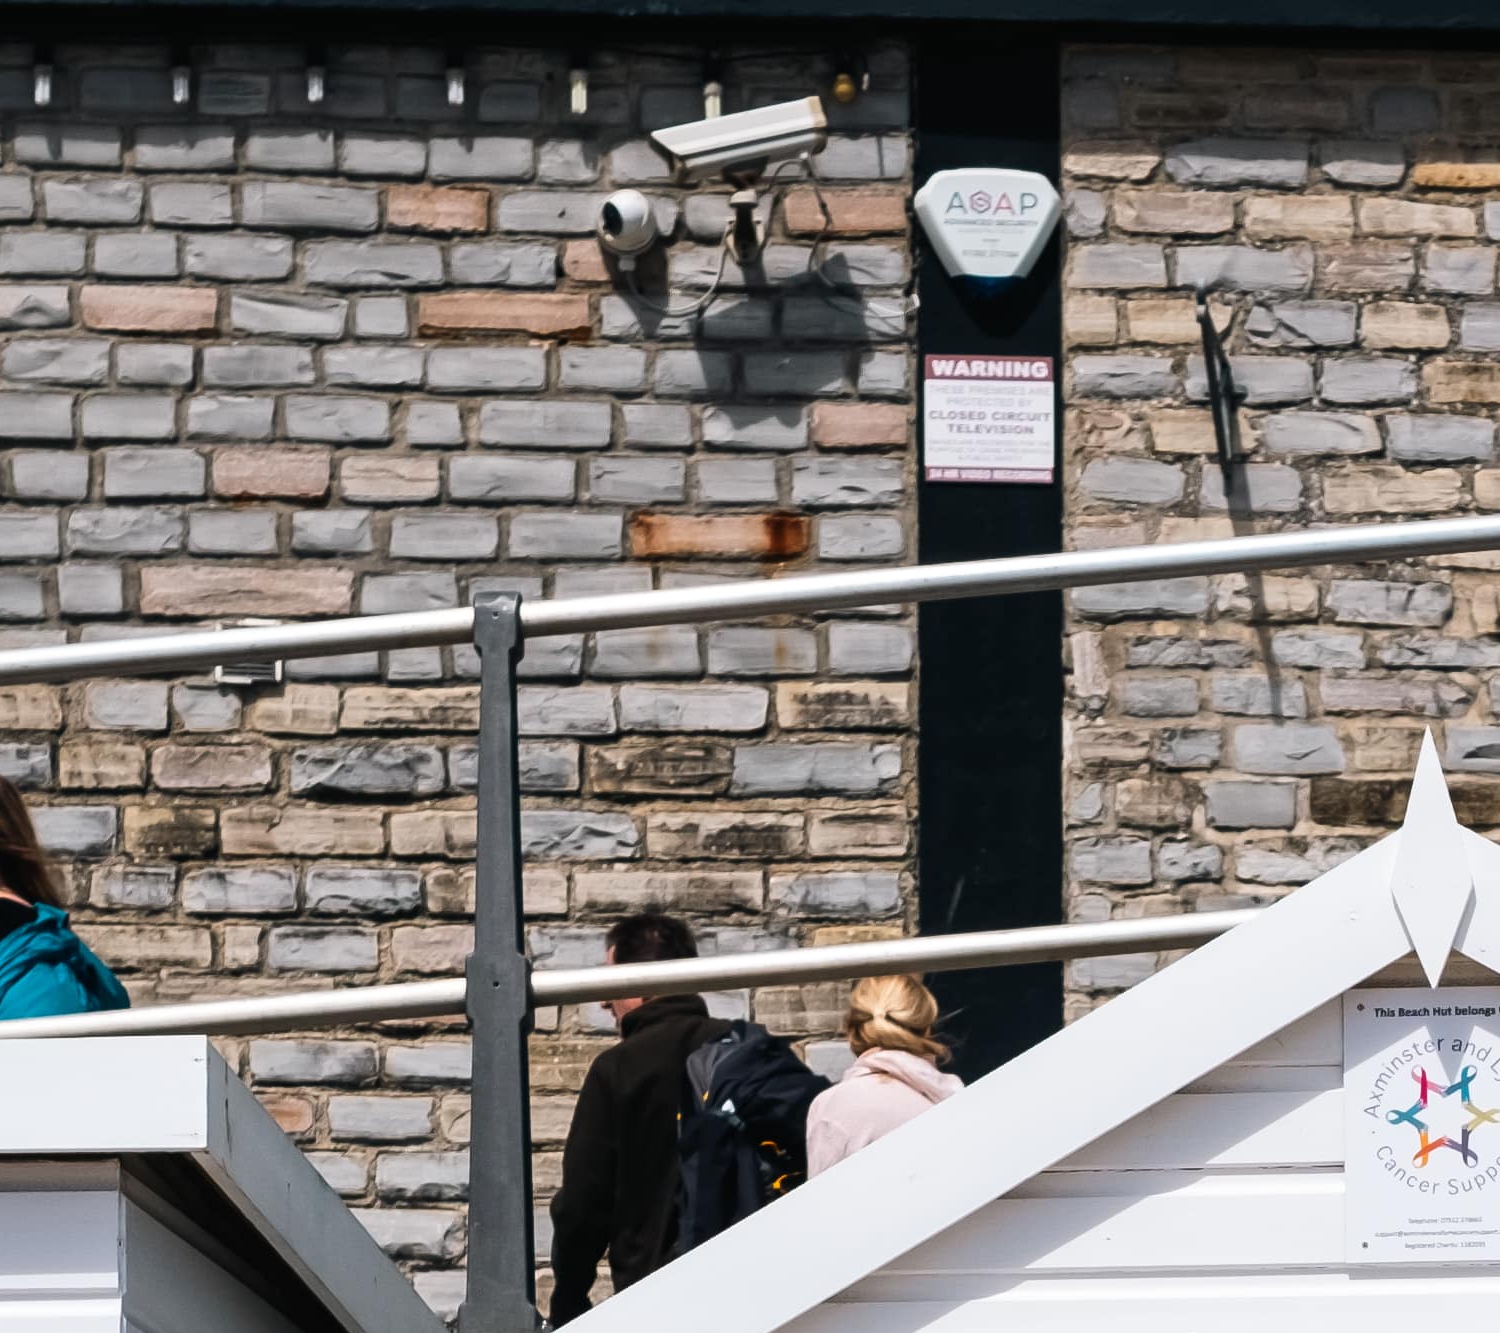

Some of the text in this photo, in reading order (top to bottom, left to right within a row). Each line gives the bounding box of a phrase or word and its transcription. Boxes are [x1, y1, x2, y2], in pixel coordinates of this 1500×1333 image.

[945, 190, 1039, 216] ASAP
[931, 359, 1049, 379] WARNING
[929, 410, 1051, 421] CLOSED CIRCUIT
[948, 423, 1035, 434] TELEVISION
[1374, 1007, 1396, 1018] This
[1398, 1006, 1430, 1018] Beach
[1432, 1006, 1453, 1017] Hut
[1454, 1005, 1496, 1017] belongs
[1363, 1037, 1445, 1119] Axminster
[1451, 1038, 1492, 1063] and
[1376, 1144, 1440, 1195] Cancer
